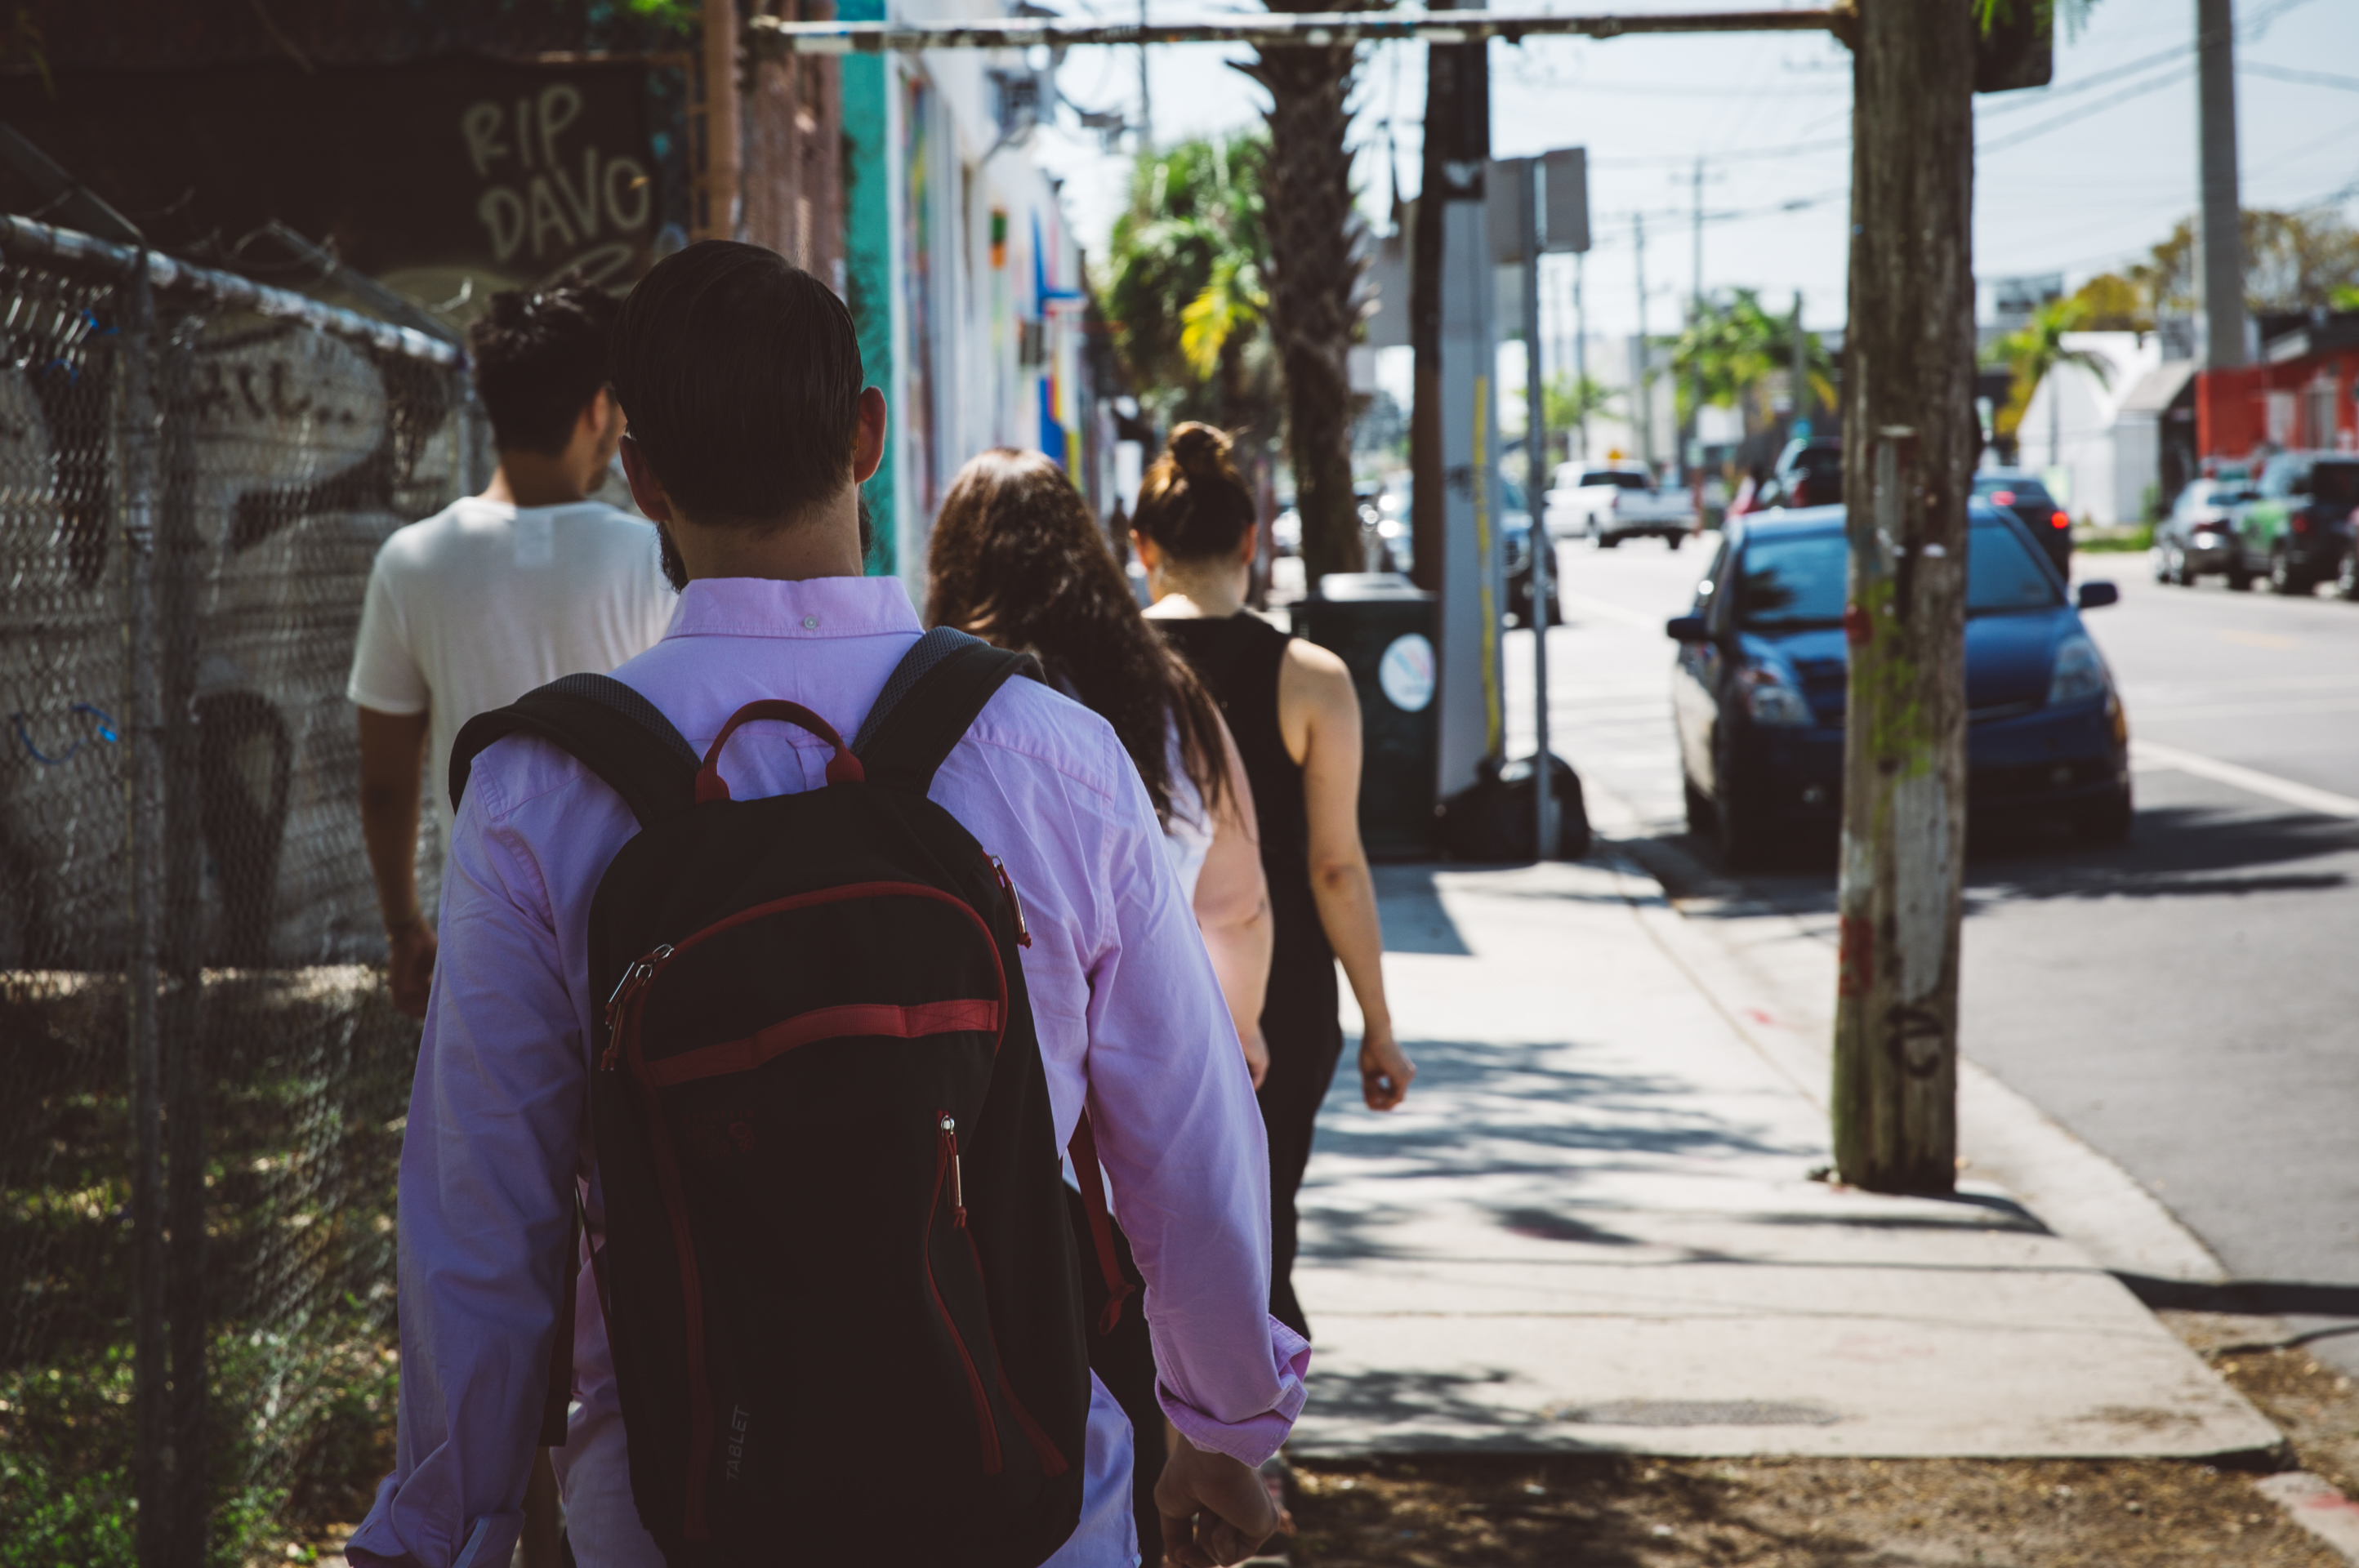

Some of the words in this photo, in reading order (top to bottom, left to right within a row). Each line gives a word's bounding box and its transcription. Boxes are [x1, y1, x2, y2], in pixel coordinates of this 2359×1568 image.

[462, 84, 582, 176] RIP
[479, 145, 649, 261] DAVO
[683, 1107, 753, 1123] MOUNTAIN
[686, 1124, 719, 1143] HARD
[697, 1140, 733, 1159] WEAR
[726, 1404, 749, 1480] TABLET
